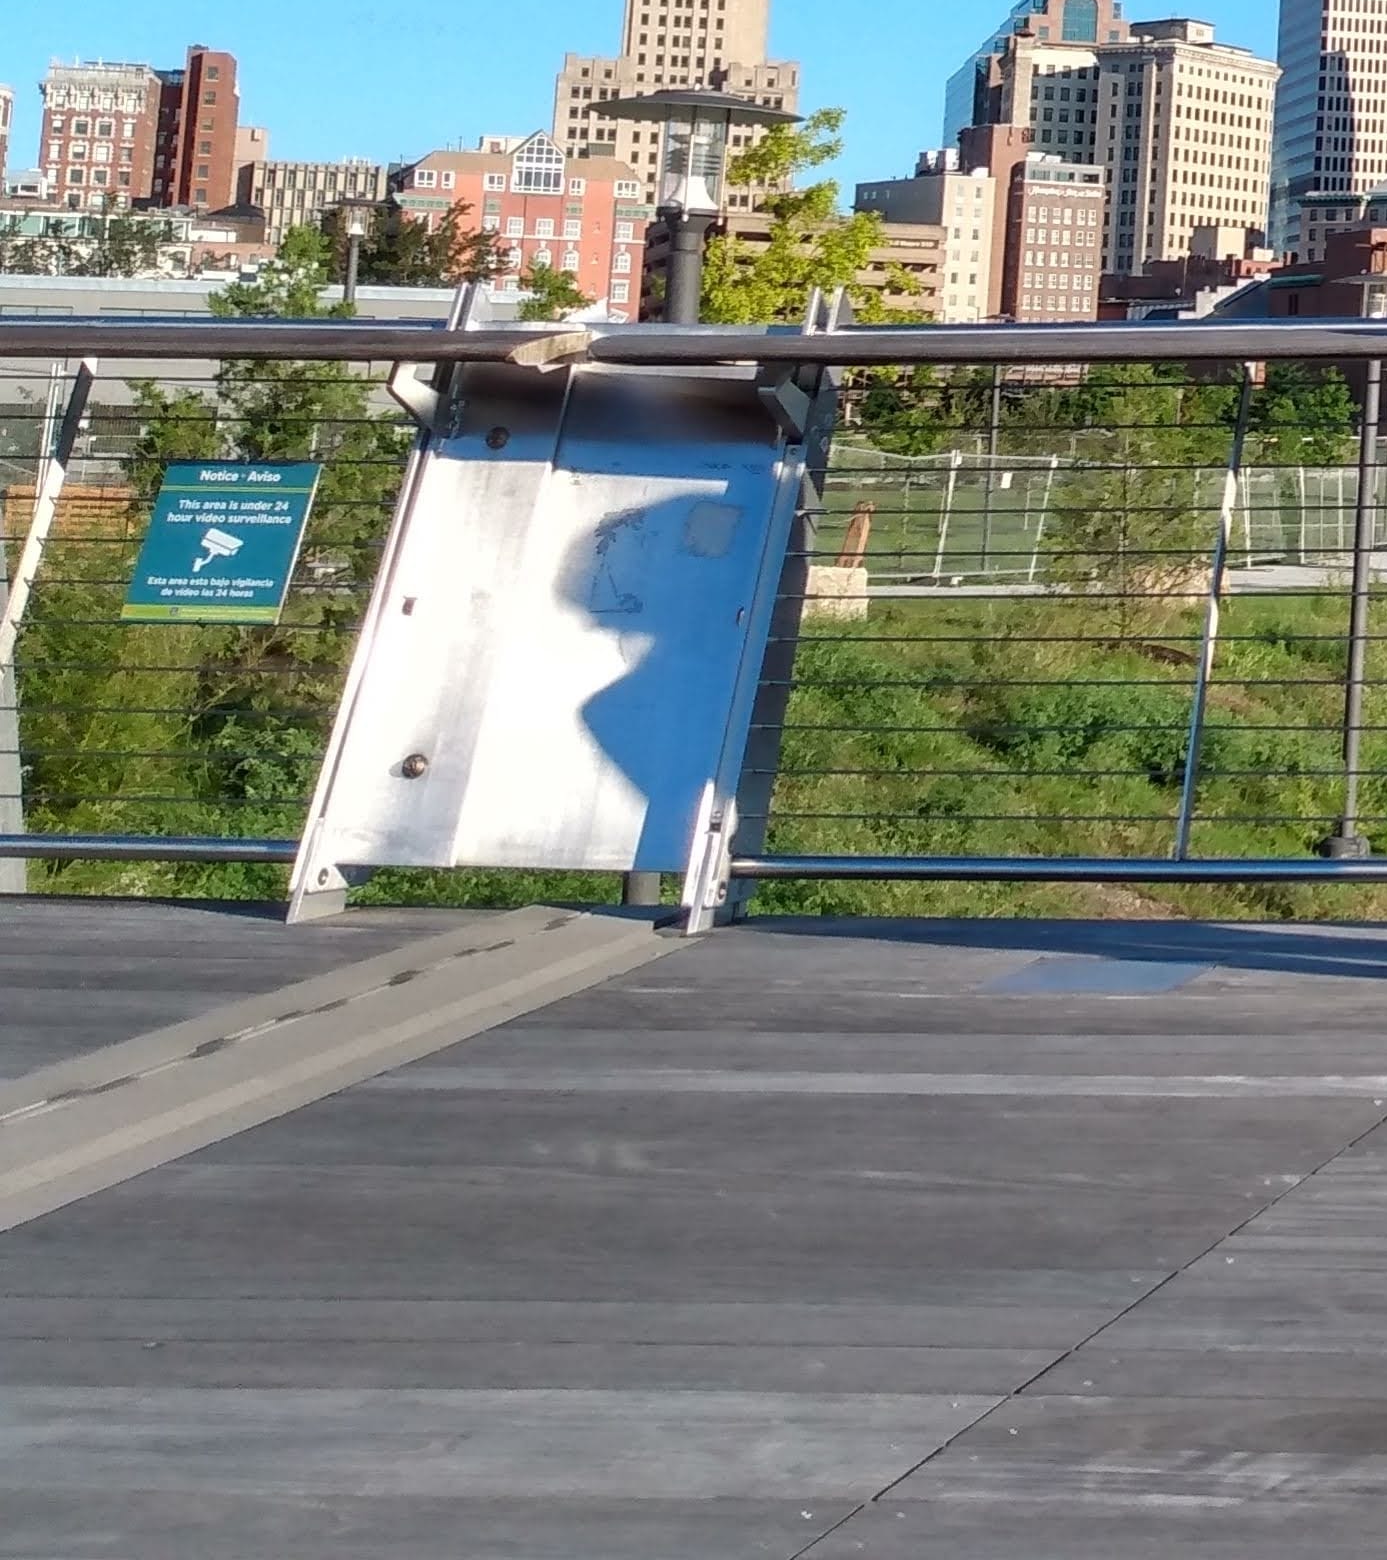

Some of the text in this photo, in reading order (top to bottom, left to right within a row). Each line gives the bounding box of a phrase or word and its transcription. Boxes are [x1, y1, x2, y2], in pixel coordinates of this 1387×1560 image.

[200, 470, 281, 482] Notice Aviso
[179, 500, 288, 511] This area is under 24
[167, 512, 292, 524] hour video surveillance
